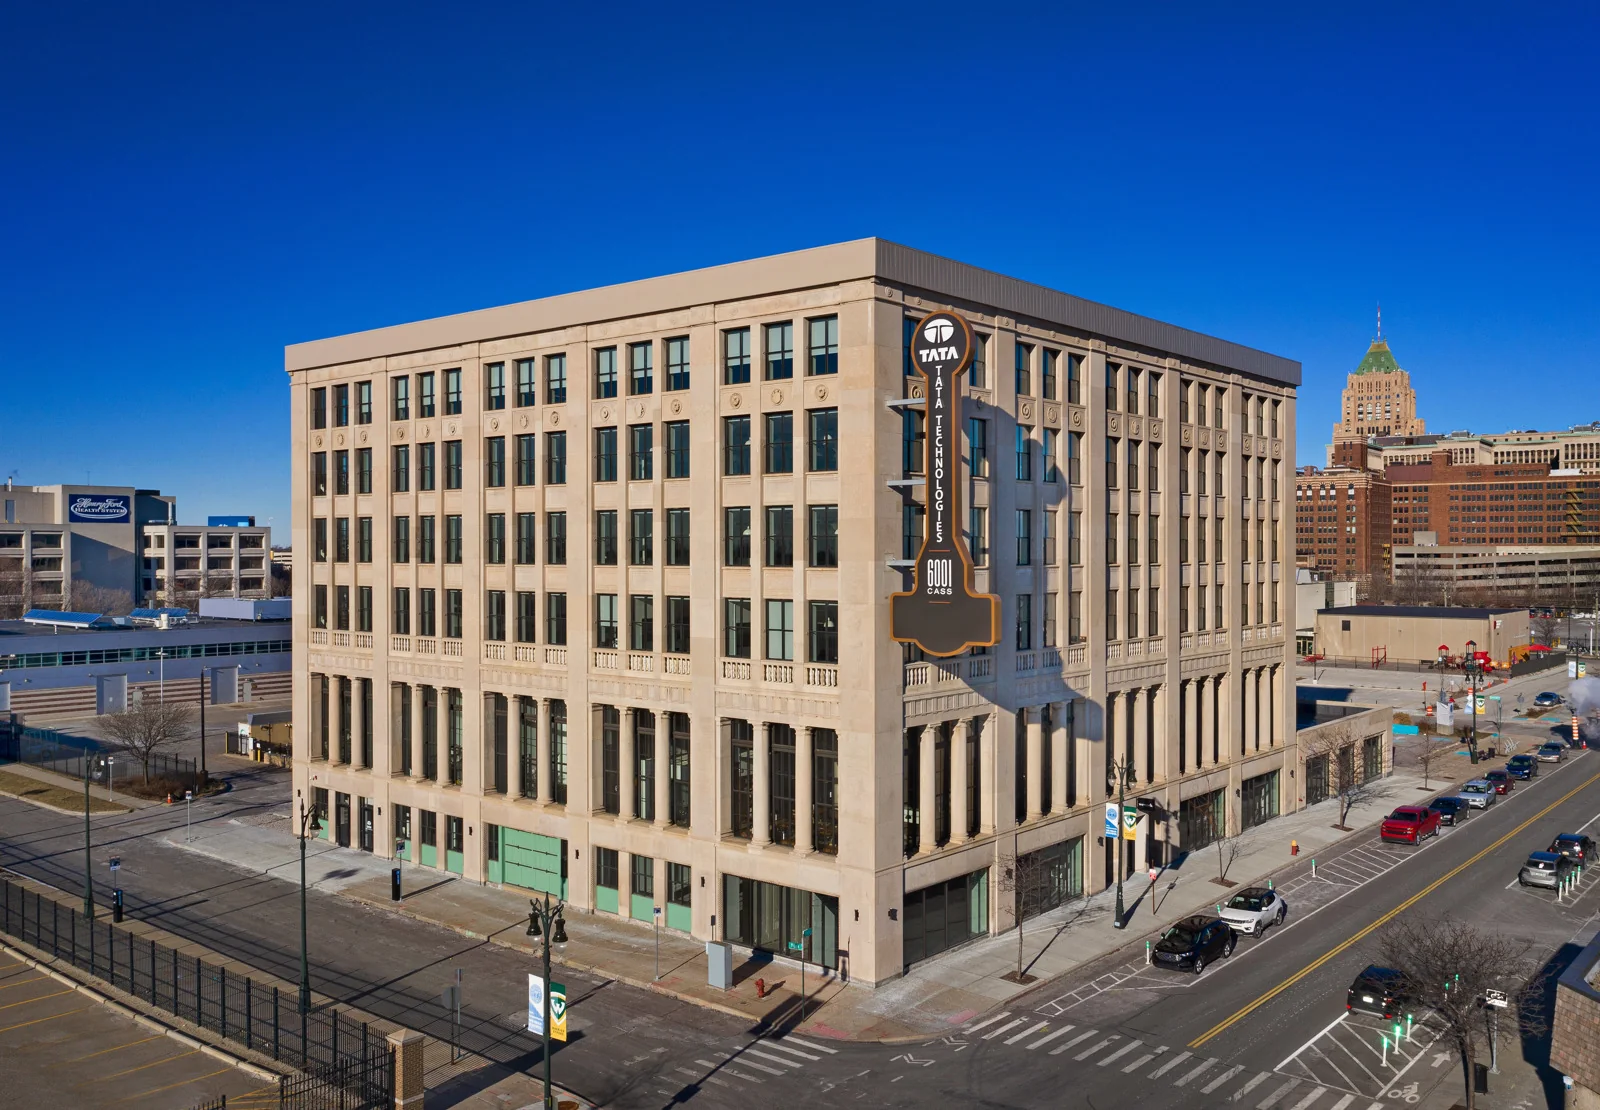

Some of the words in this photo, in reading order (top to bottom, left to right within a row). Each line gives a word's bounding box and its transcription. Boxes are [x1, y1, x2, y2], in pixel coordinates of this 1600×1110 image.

[919, 346, 959, 363] TATA
[935, 365, 944, 409] TATA
[935, 415, 944, 543] TECHNOLOGIES
[76, 497, 106, 509] Henry
[105, 498, 124, 508] Ford
[927, 559, 952, 588] 6001
